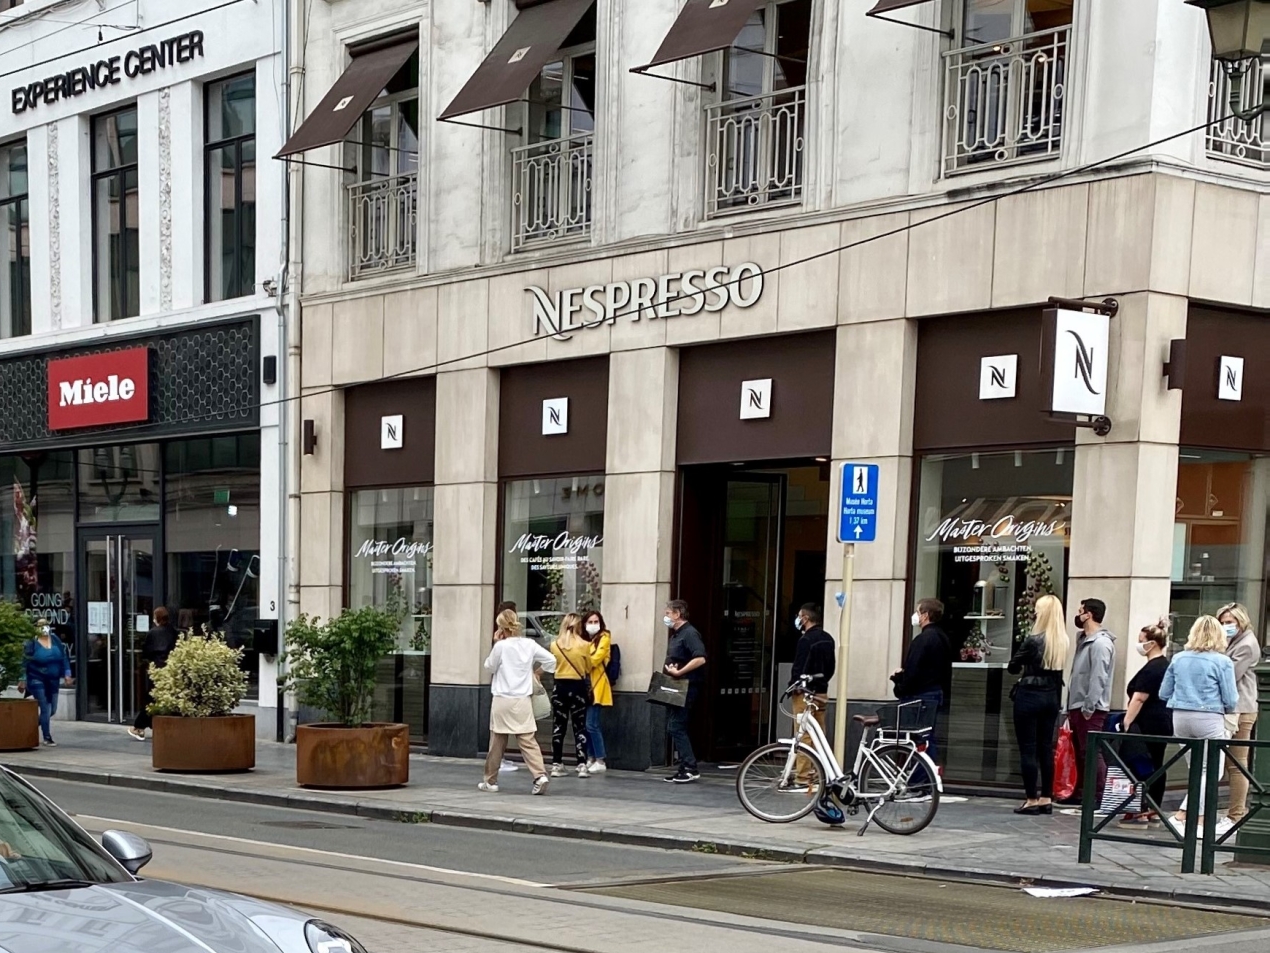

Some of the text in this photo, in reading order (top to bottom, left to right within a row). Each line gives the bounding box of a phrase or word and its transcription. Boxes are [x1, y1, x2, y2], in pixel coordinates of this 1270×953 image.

[11, 29, 204, 114] EXPERIENCE CENTER
[523, 261, 765, 341] NESPRESSO
[59, 374, 135, 407] Miele
[926, 515, 1065, 542] Master Origins
[354, 537, 434, 558] Master Origins
[509, 531, 604, 553] Master Origins
[31, 593, 62, 607] GOING
[270, 601, 275, 611] 3
